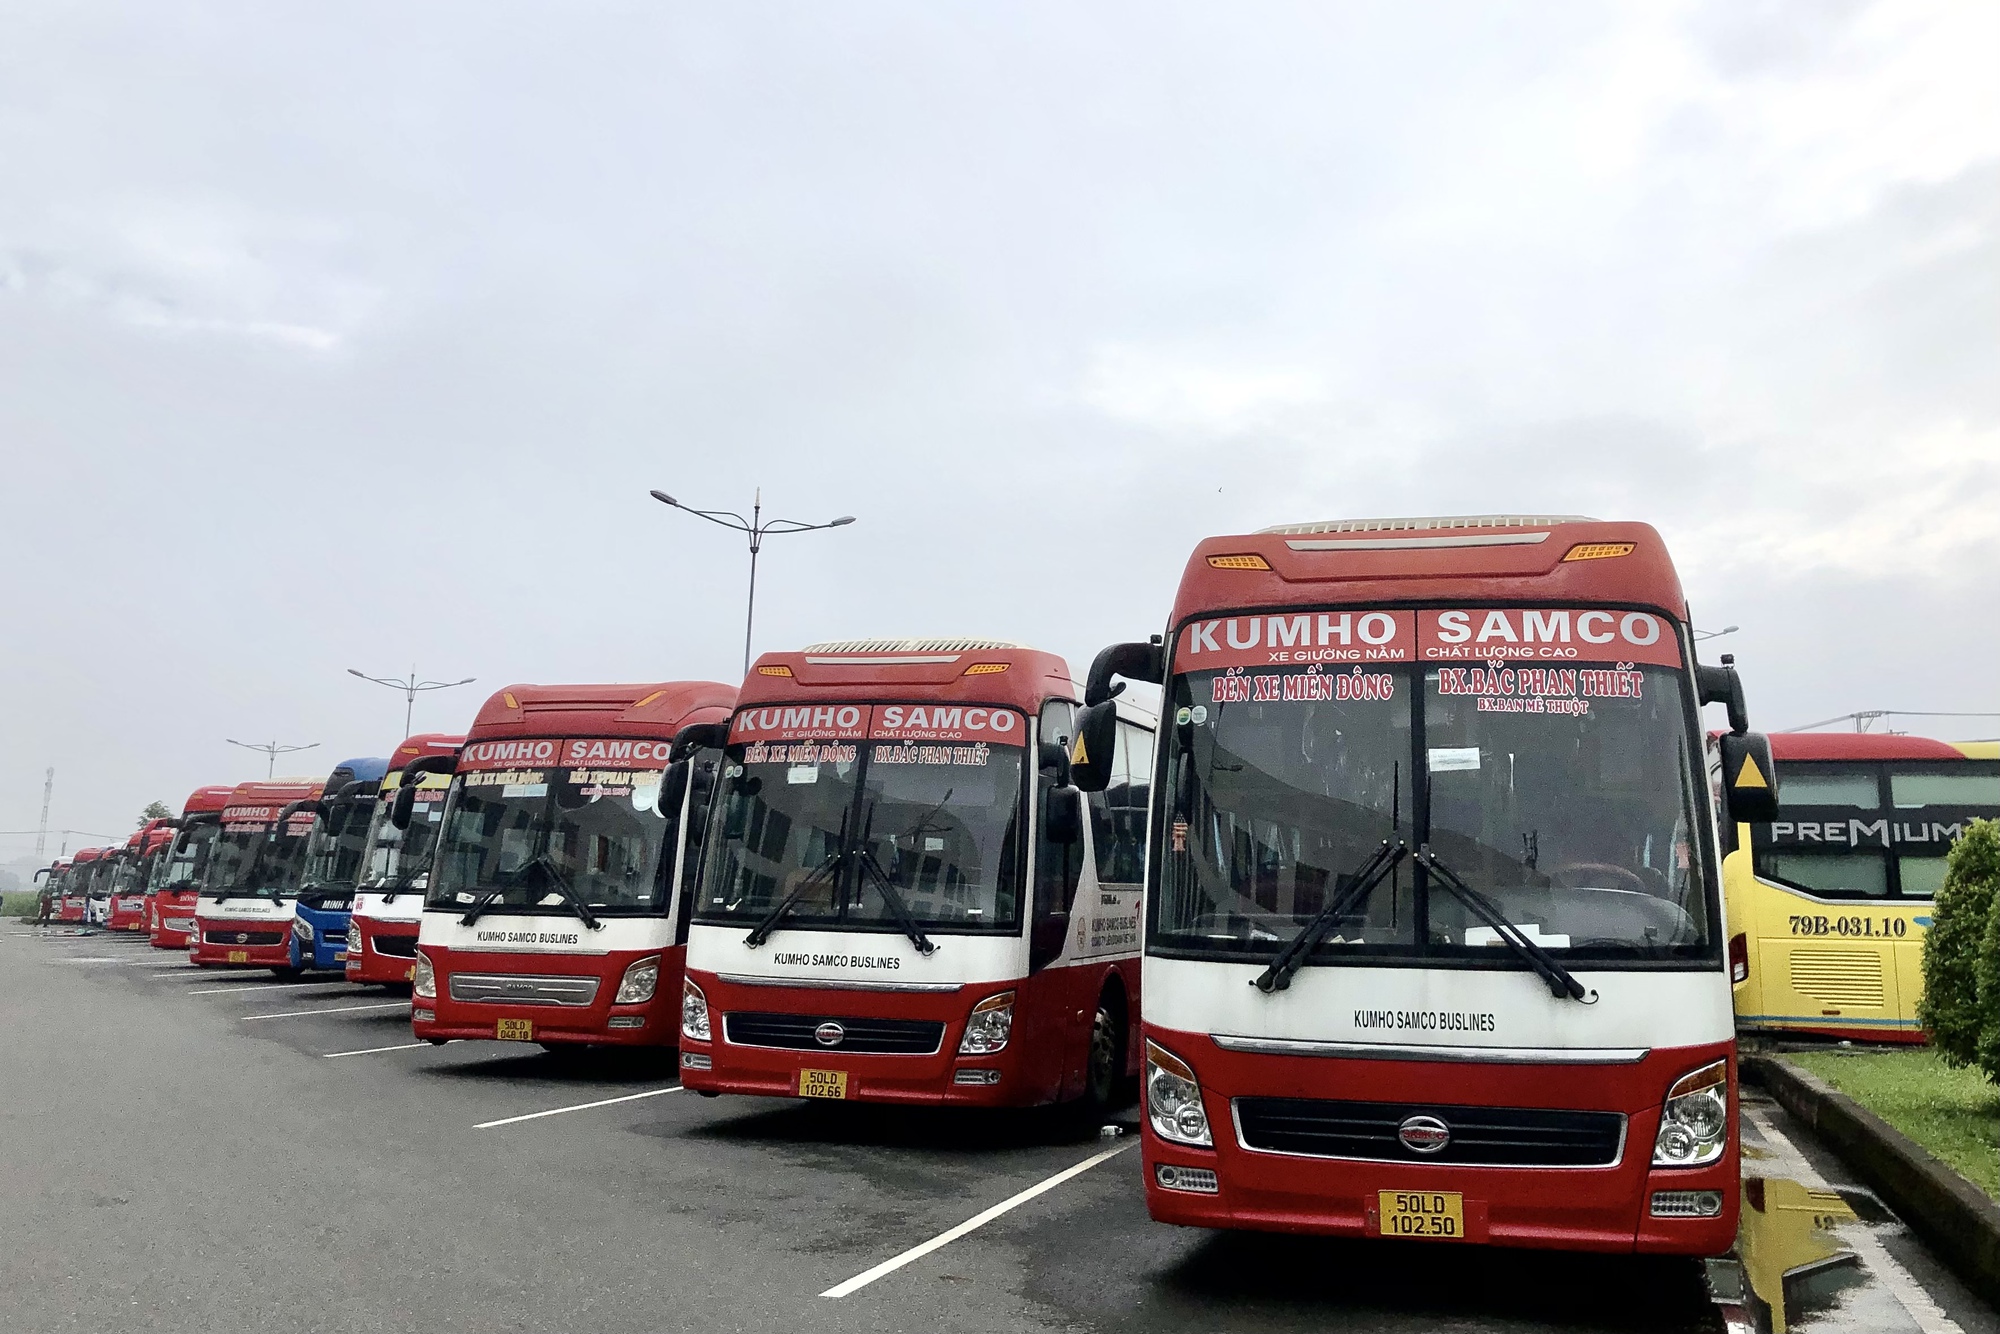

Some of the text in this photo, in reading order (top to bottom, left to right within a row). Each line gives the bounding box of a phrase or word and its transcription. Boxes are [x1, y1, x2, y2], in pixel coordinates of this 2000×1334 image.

[1190, 610, 1660, 654] KUMHO SAMCO
[1268, 651, 1289, 662] XE
[1294, 647, 1361, 661] GIƯỜNG
[1425, 644, 1578, 660] CHẤT LƯỢNG CAO
[1212, 663, 1394, 702] BẾN XE MIỀN ĐÔNG
[1438, 660, 1643, 698] BX.BẮC PHAN THIẾT
[1477, 696, 1589, 717] BX.BAN MÊ THUỘT
[738, 707, 1015, 732] KUMHO SAMCO
[781, 730, 794, 738] XE
[462, 741, 672, 763] KUMHO SAMCO
[769, 745, 787, 763] XE
[919, 746, 952, 764] PHAN
[223, 807, 270, 818] KUMHO
[1789, 915, 1907, 937] 79B-031.10
[477, 931, 578, 944] KUMHO SAMCO BUSLINES
[774, 953, 900, 969] KUMHO SAMCO BUSLINES
[1354, 1010, 1495, 1031] KUMHO SAMCO BUSLINES
[810, 1072, 837, 1085] 50LD
[806, 1084, 841, 1098] 102.66
[1396, 1194, 1445, 1213] 50LD
[1391, 1215, 1455, 1235] 102.50
